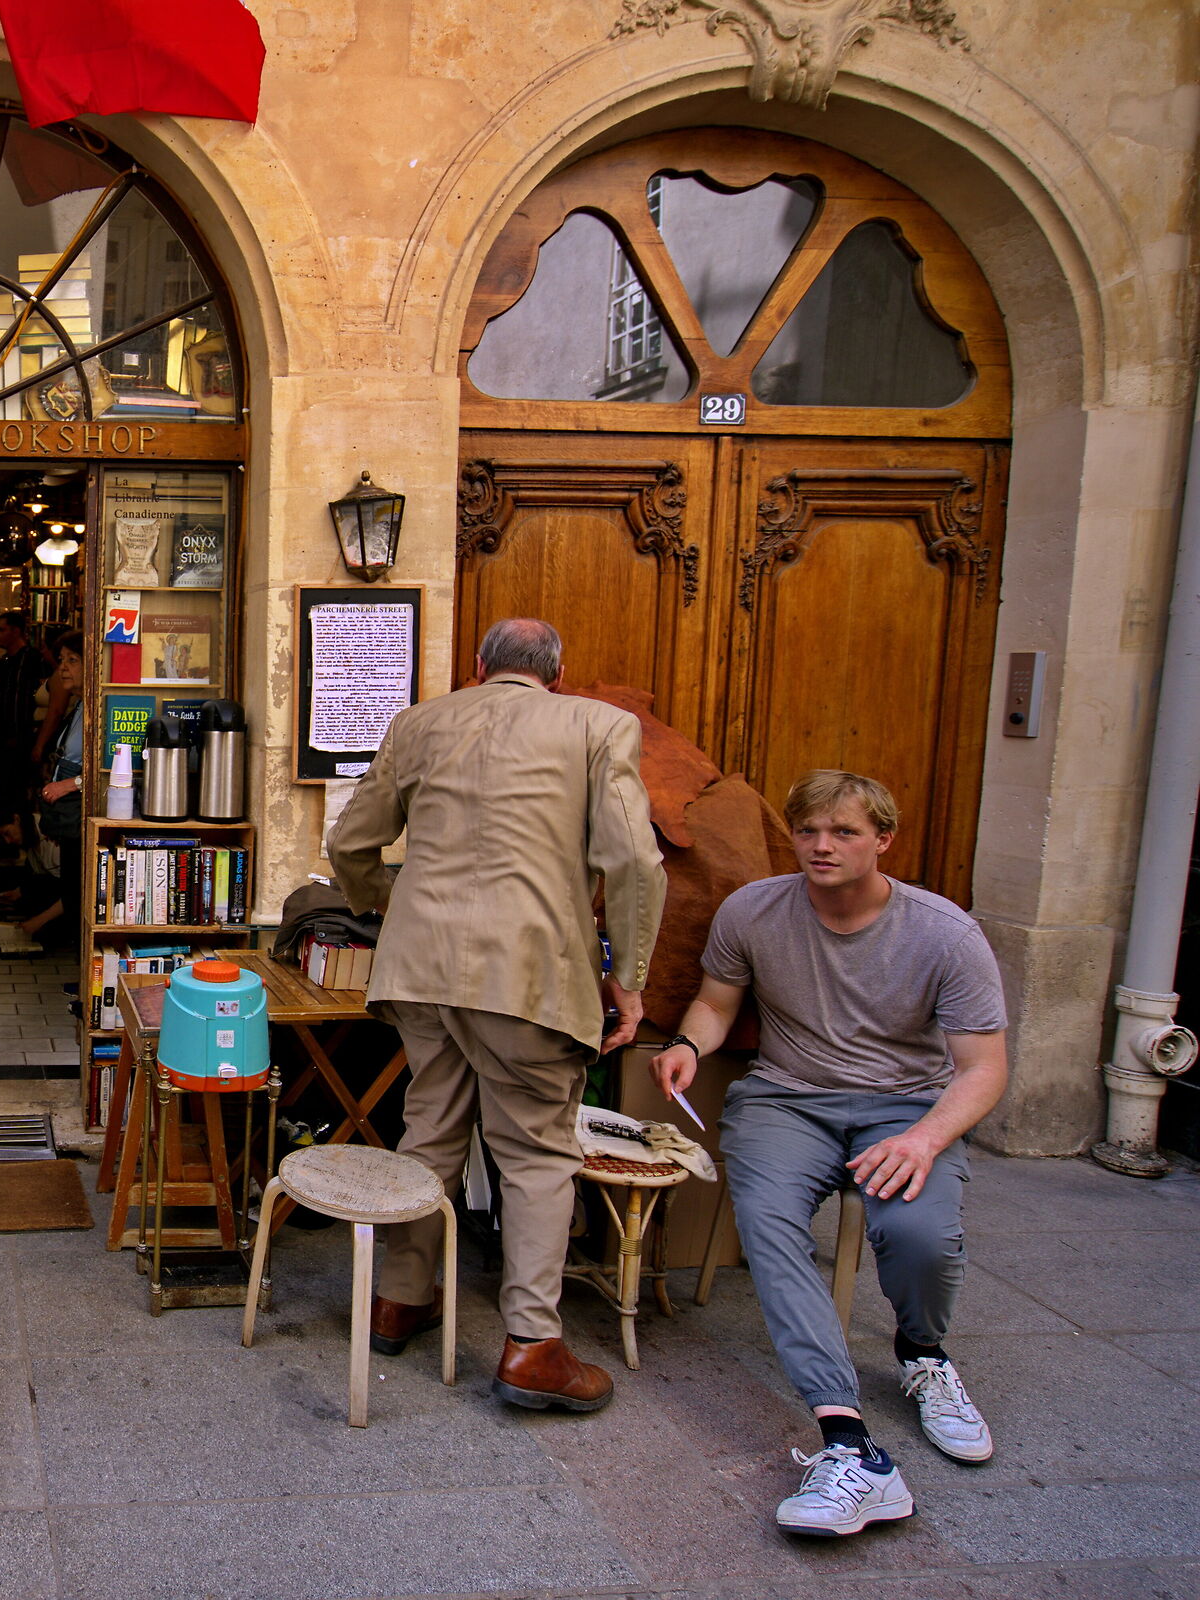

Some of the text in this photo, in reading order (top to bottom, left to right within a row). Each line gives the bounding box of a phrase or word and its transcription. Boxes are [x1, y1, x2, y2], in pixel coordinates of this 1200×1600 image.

[705, 396, 741, 421] 29
[115, 476, 128, 486] La
[115, 492, 160, 503] Librairie
[114, 508, 175, 519] Canadienne
[182, 536, 216, 549] ONYX
[180, 552, 218, 564] STORM
[113, 711, 148, 721] DAVID
[113, 721, 147, 732] LODGE
[121, 736, 139, 744] DEAF
[156, 857, 166, 888] SON
[235, 874, 243, 883] 62
